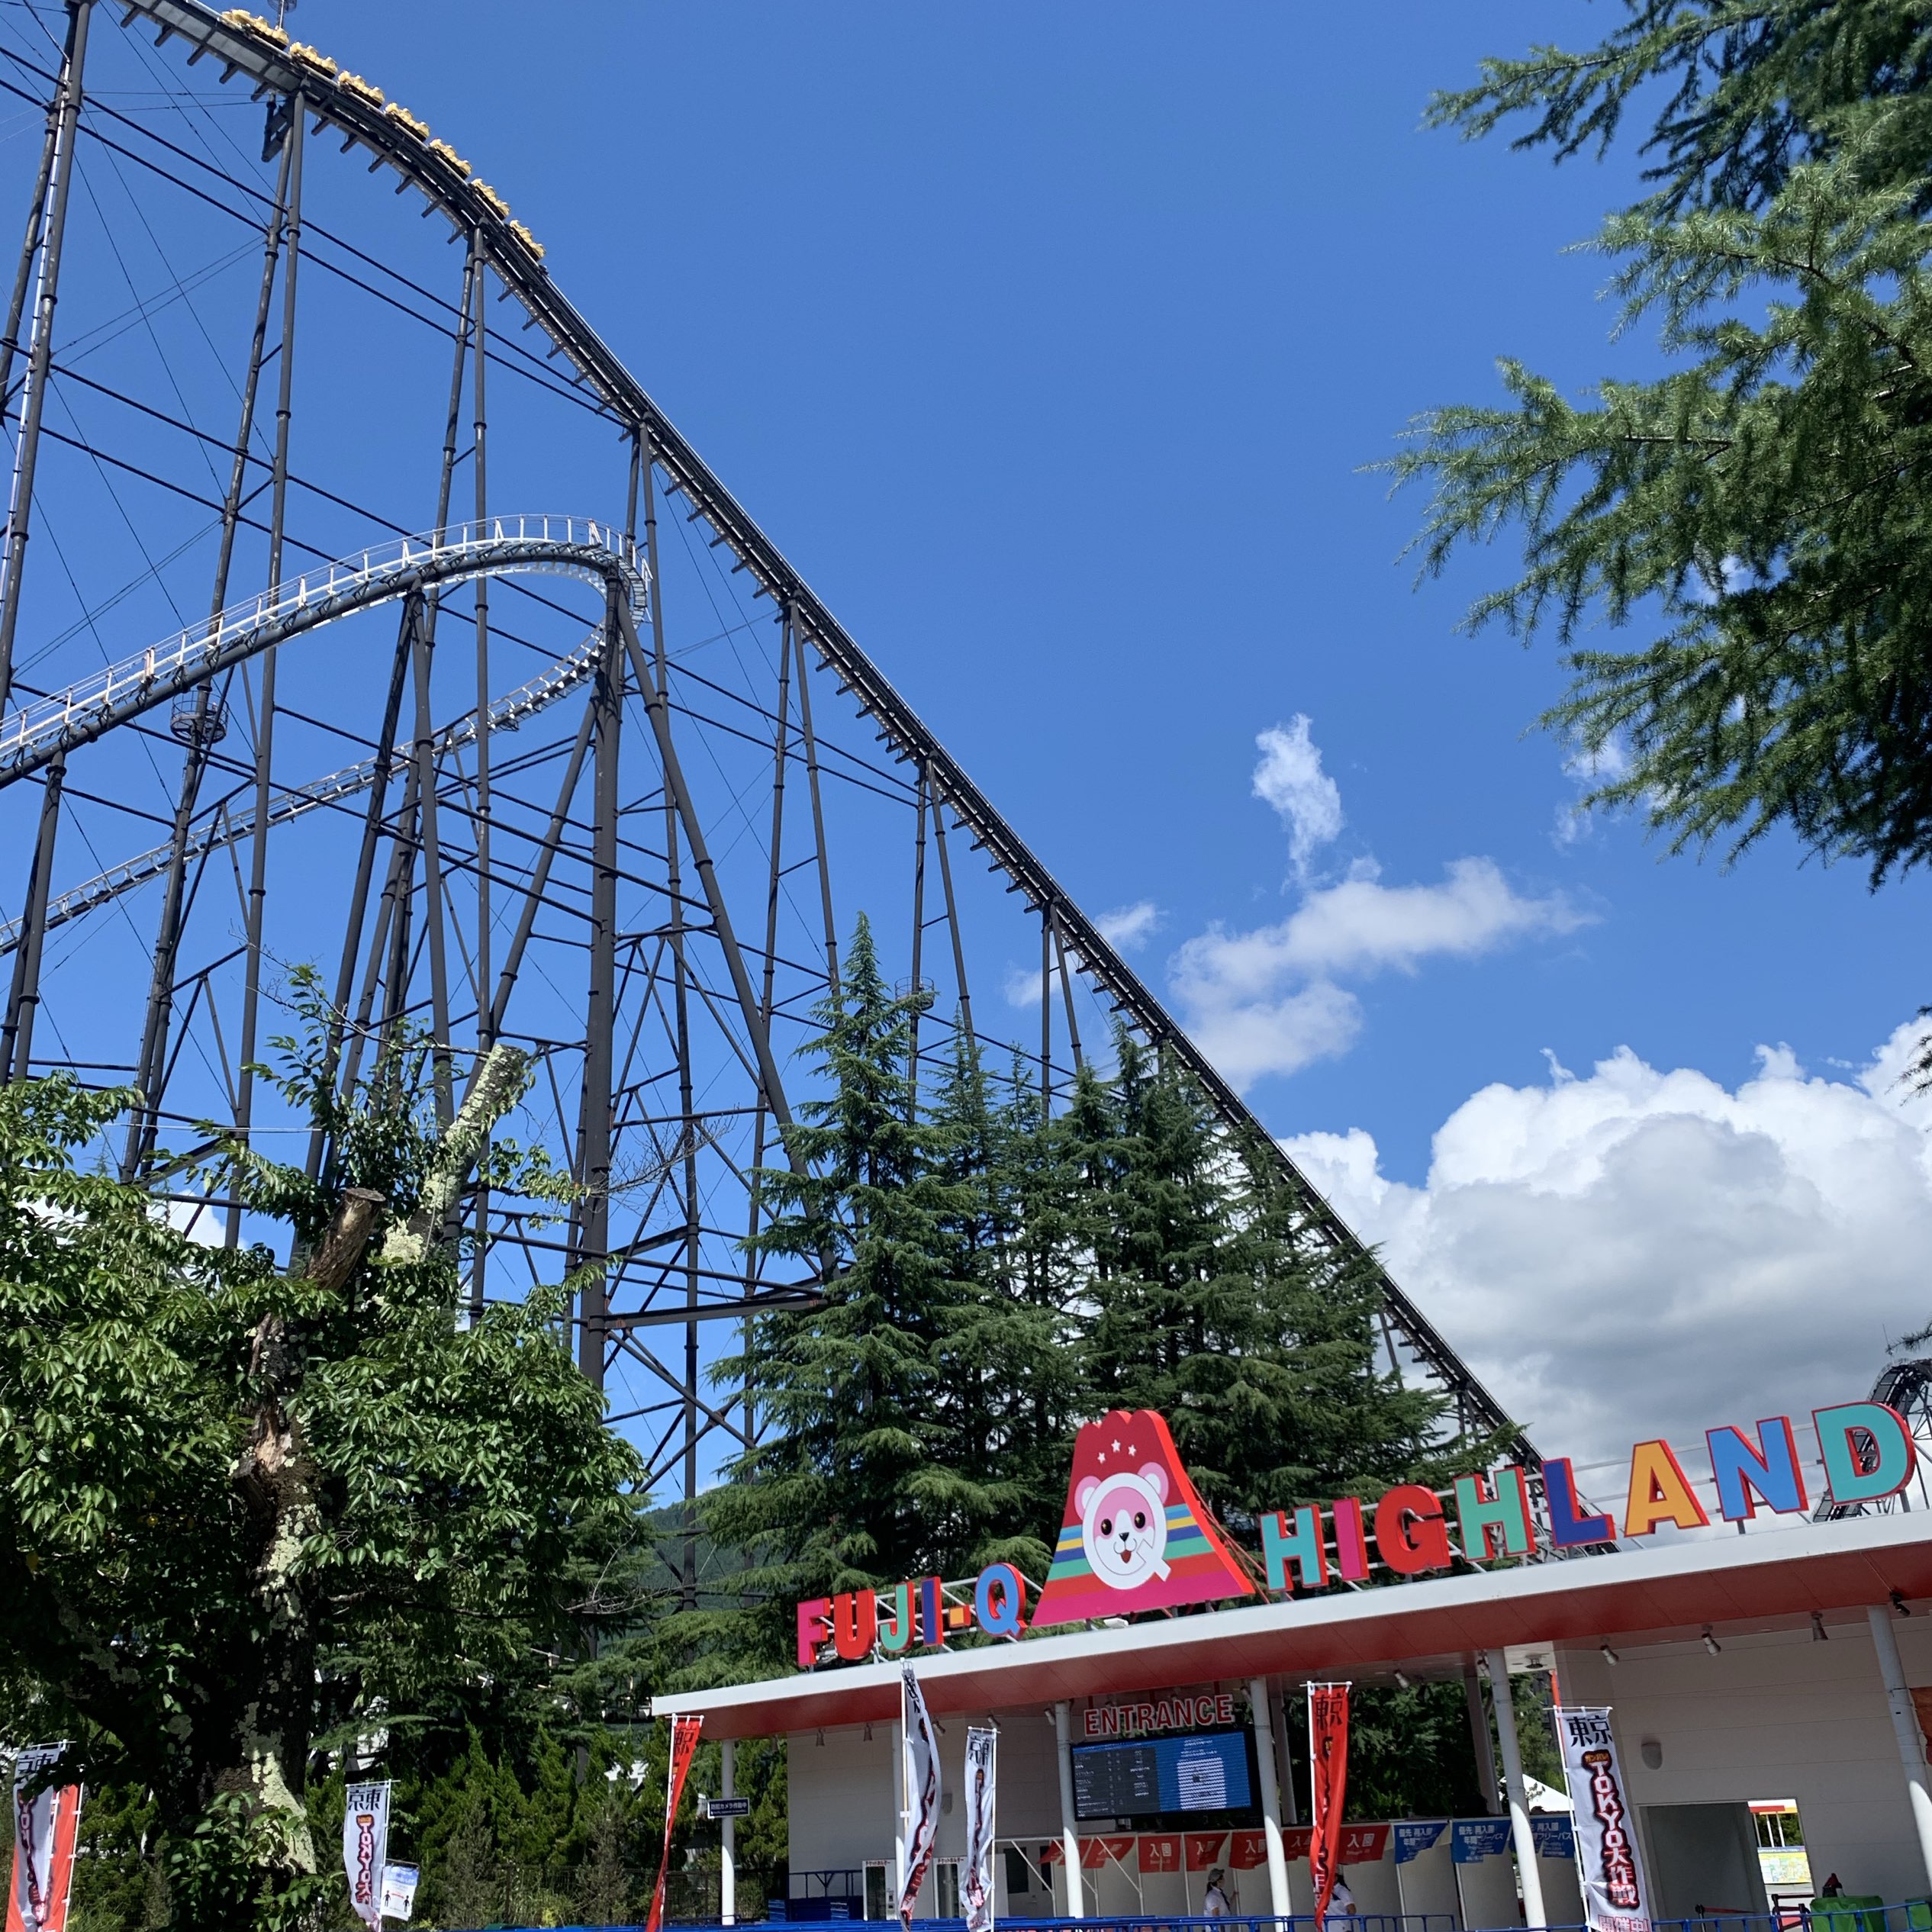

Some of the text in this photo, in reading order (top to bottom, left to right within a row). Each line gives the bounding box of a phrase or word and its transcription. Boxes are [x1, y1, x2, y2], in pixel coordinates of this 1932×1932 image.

[797, 1401, 1916, 1666] FUJI-Q HIGHLAND
[1084, 1693, 1235, 1737] ENTRANCE
[1567, 1715, 1613, 1747] 東京
[1149, 1843, 1172, 1858] 入園
[1347, 1833, 1374, 1848] 入園
[1588, 1760, 1637, 1905] TOKYO大作戦
